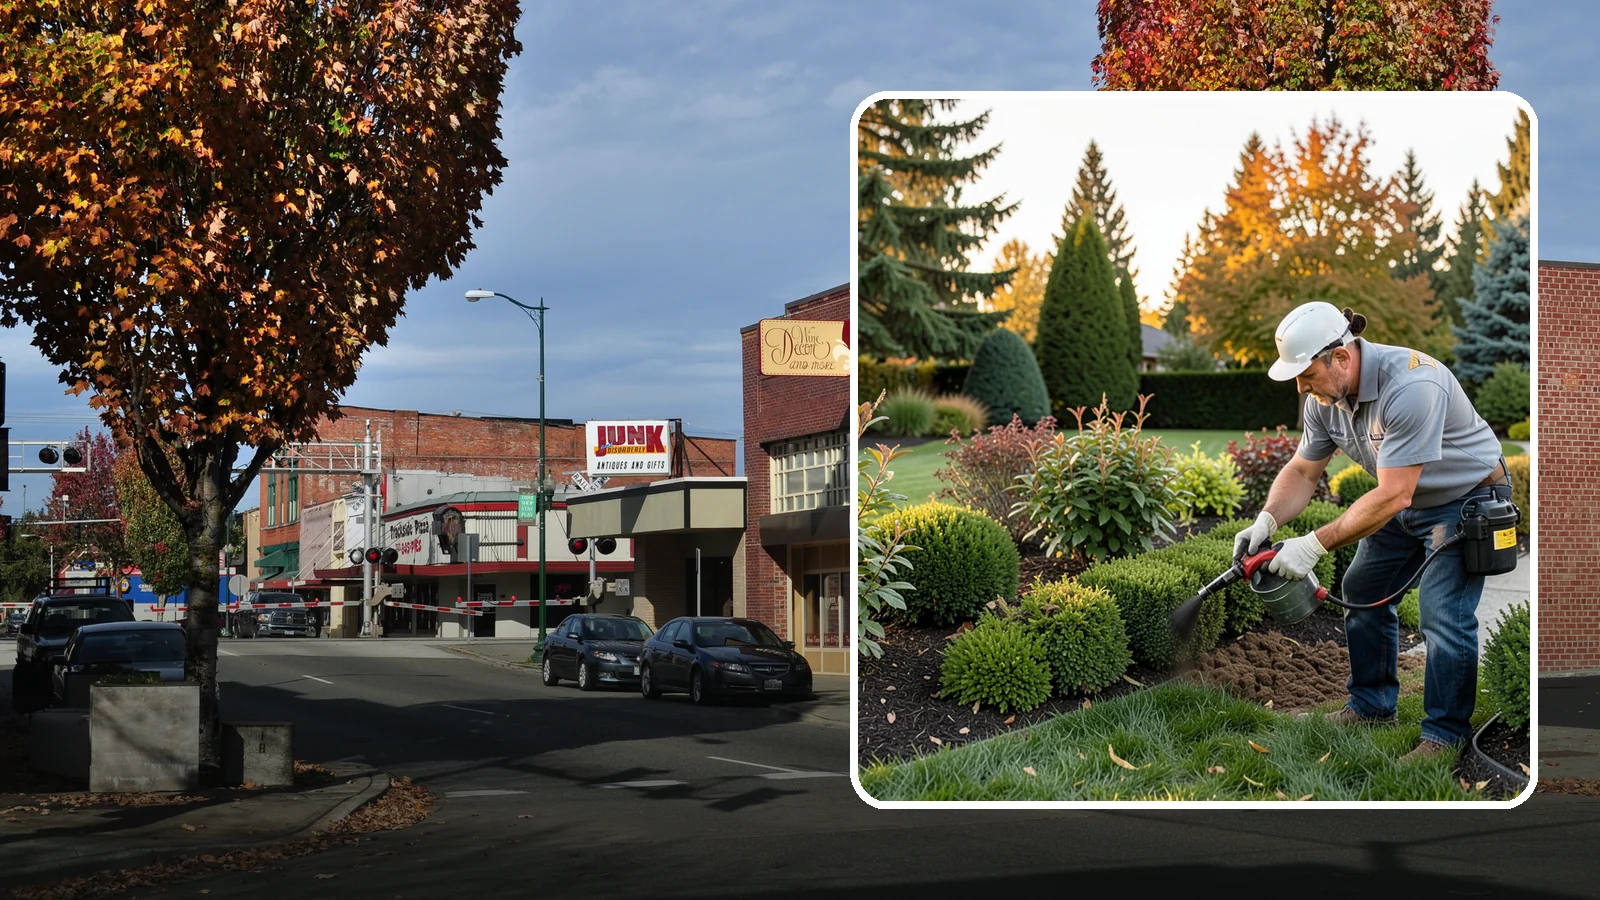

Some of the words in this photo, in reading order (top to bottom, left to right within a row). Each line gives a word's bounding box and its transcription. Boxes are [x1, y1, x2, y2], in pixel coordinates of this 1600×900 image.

[595, 425, 665, 457] JUNK
[607, 446, 646, 454] DISORDERLY
[597, 461, 628, 470] ANTIQUES
[631, 461, 644, 470] AND
[647, 461, 665, 469] GIFTS
